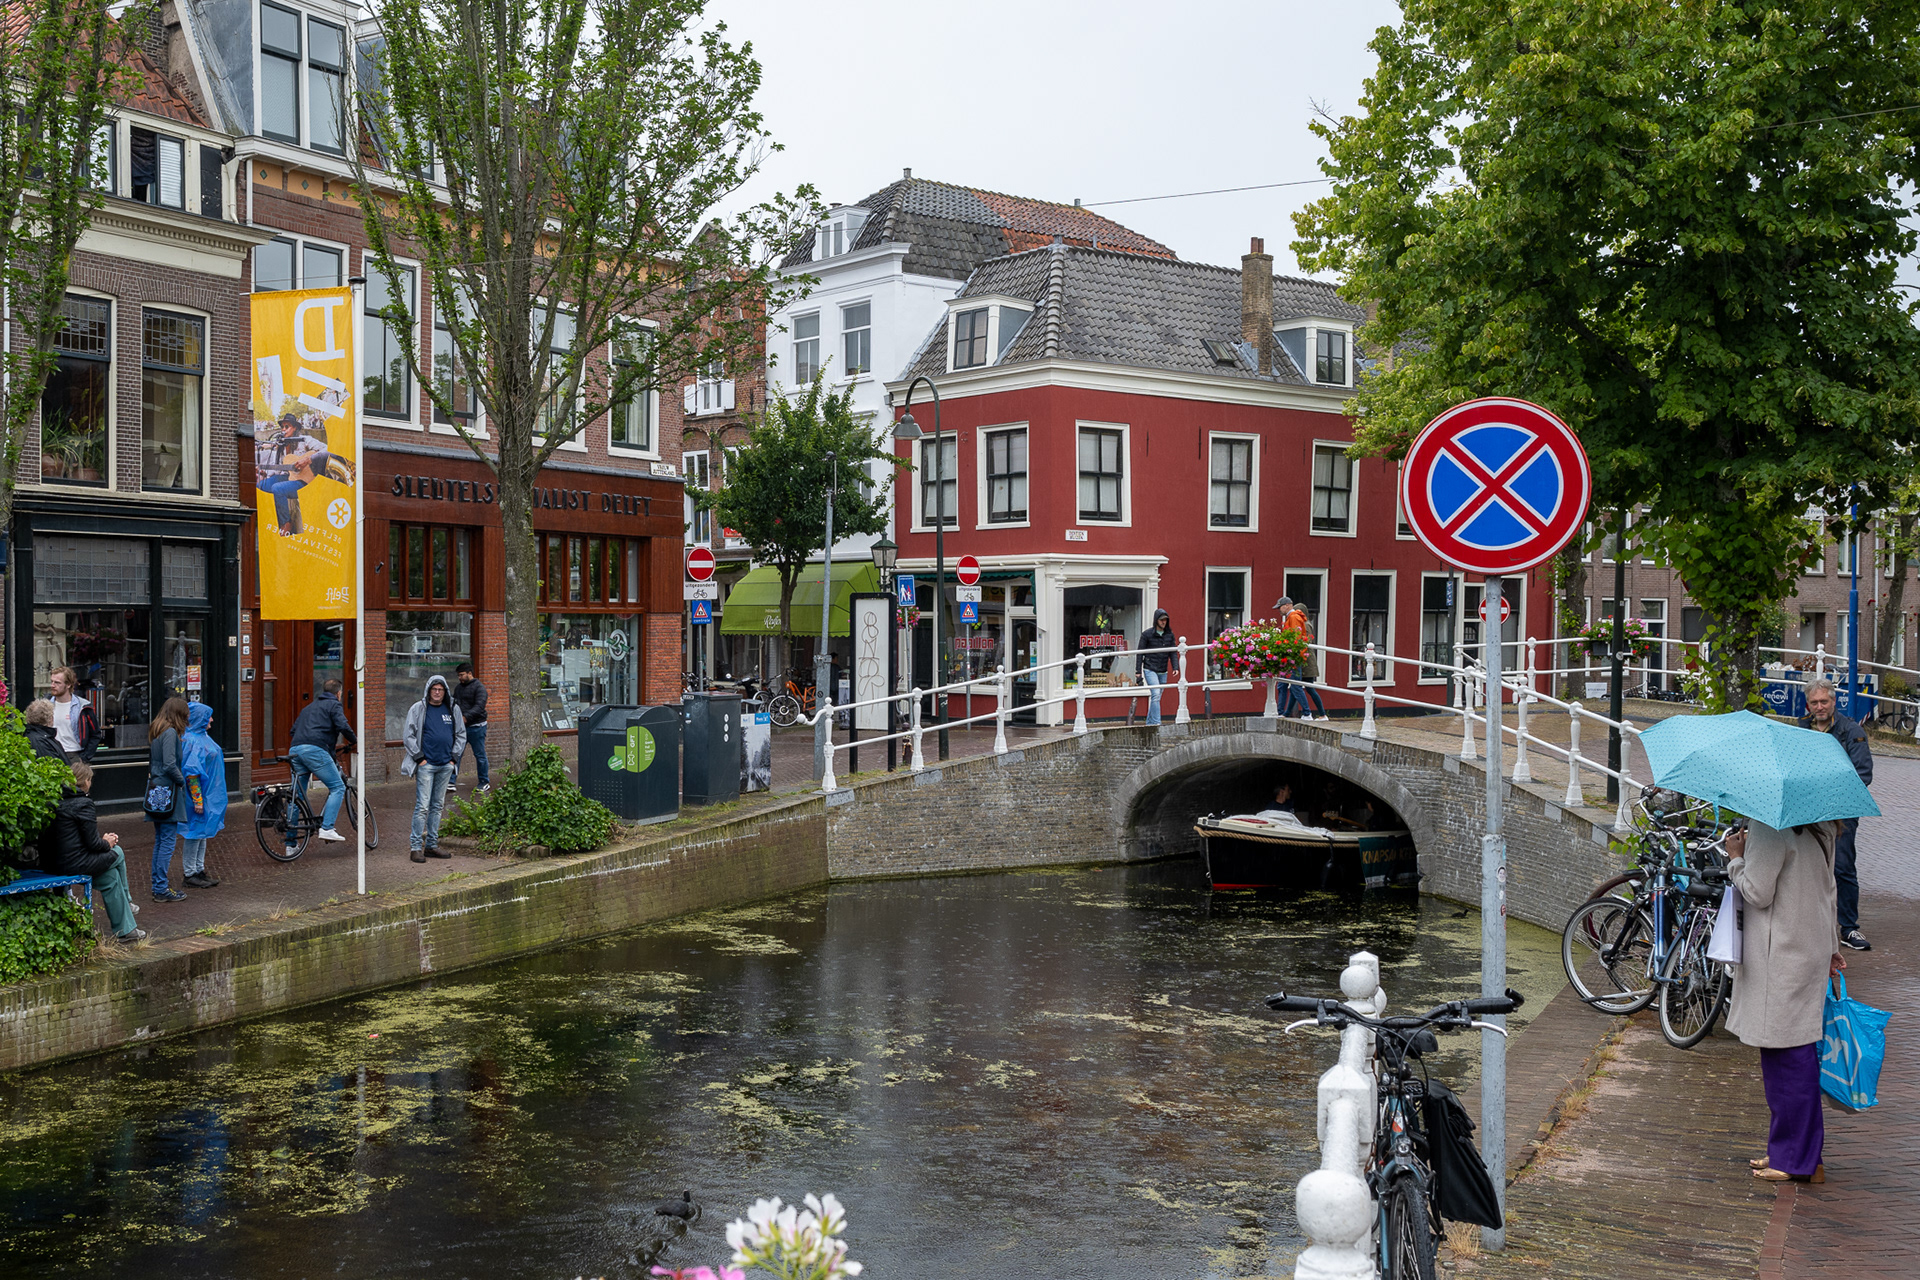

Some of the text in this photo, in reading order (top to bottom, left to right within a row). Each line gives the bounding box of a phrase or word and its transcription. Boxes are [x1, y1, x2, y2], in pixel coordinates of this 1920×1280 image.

[391, 473, 653, 517] SLEUTELSIALIST DELFT
[1080, 632, 1124, 649] papillon
[1763, 692, 1789, 701] renewi
